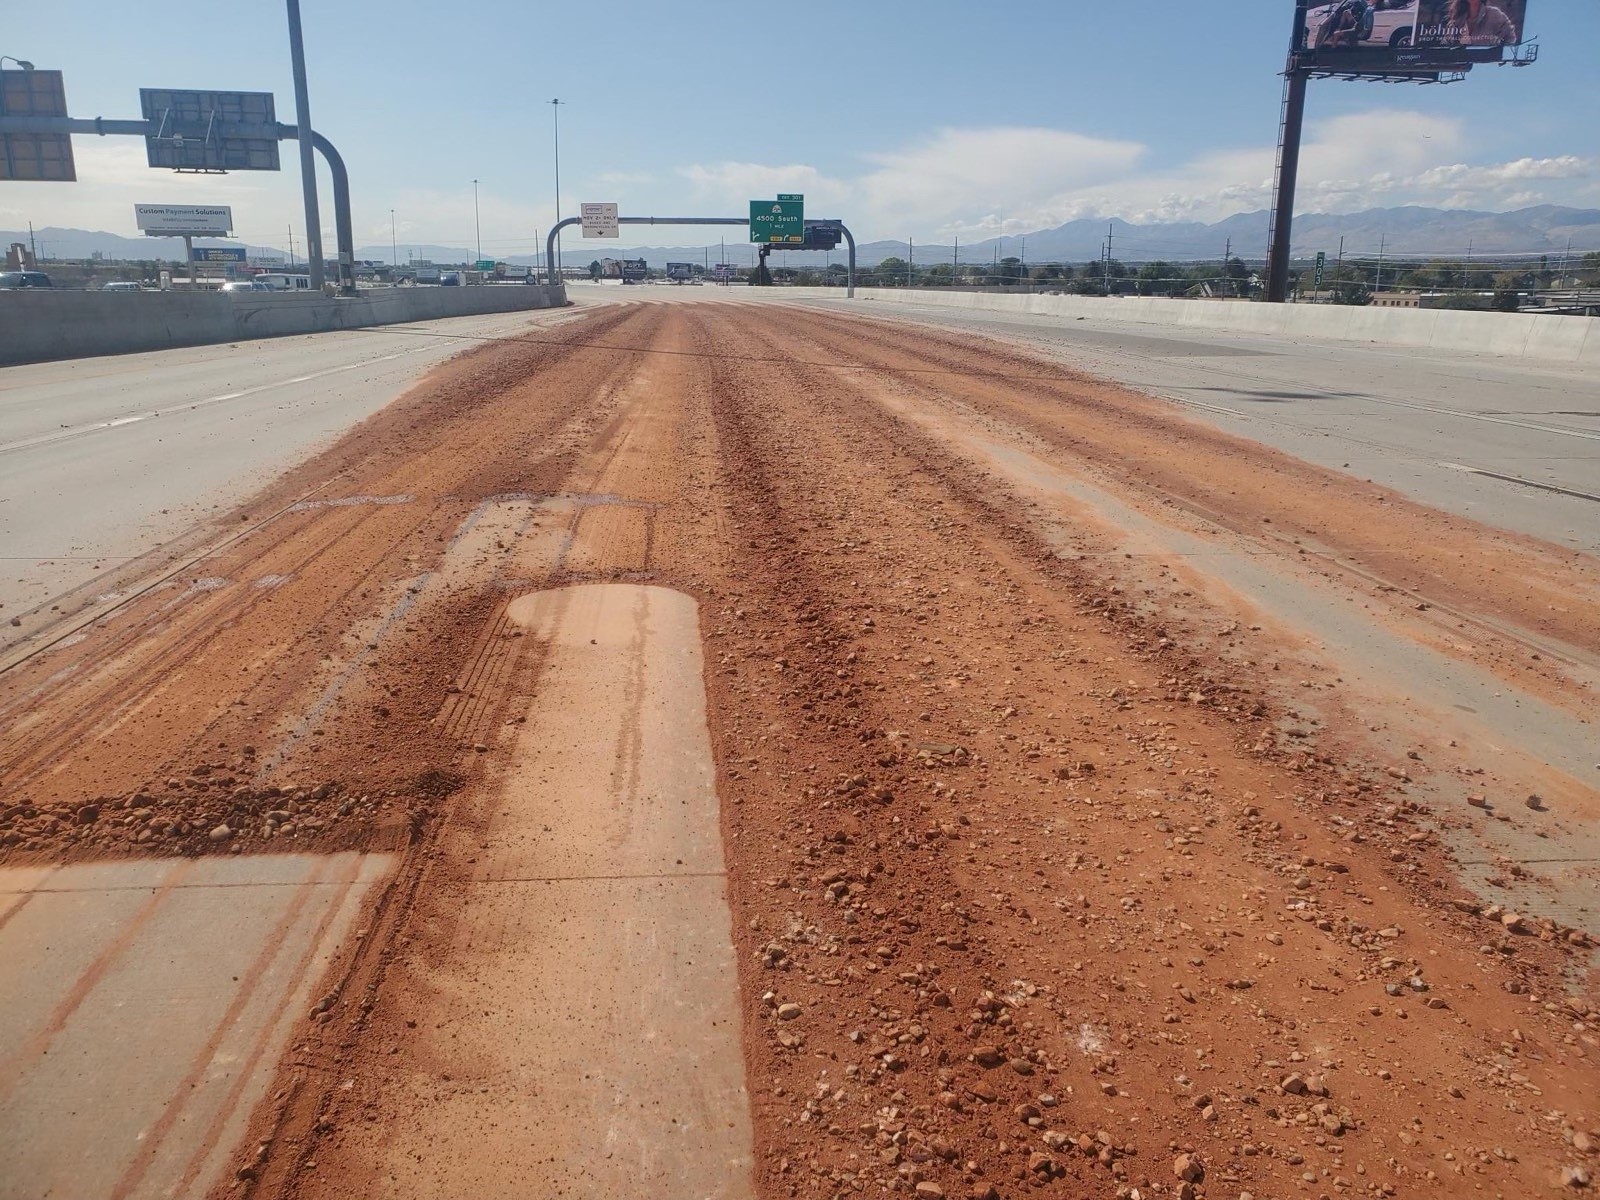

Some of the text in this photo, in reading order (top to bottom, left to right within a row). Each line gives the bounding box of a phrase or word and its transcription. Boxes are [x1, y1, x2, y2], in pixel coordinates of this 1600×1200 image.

[1420, 24, 1467, 36] böhme
[166, 208, 195, 216] Payment
[1315, 258, 1323, 285] 303
